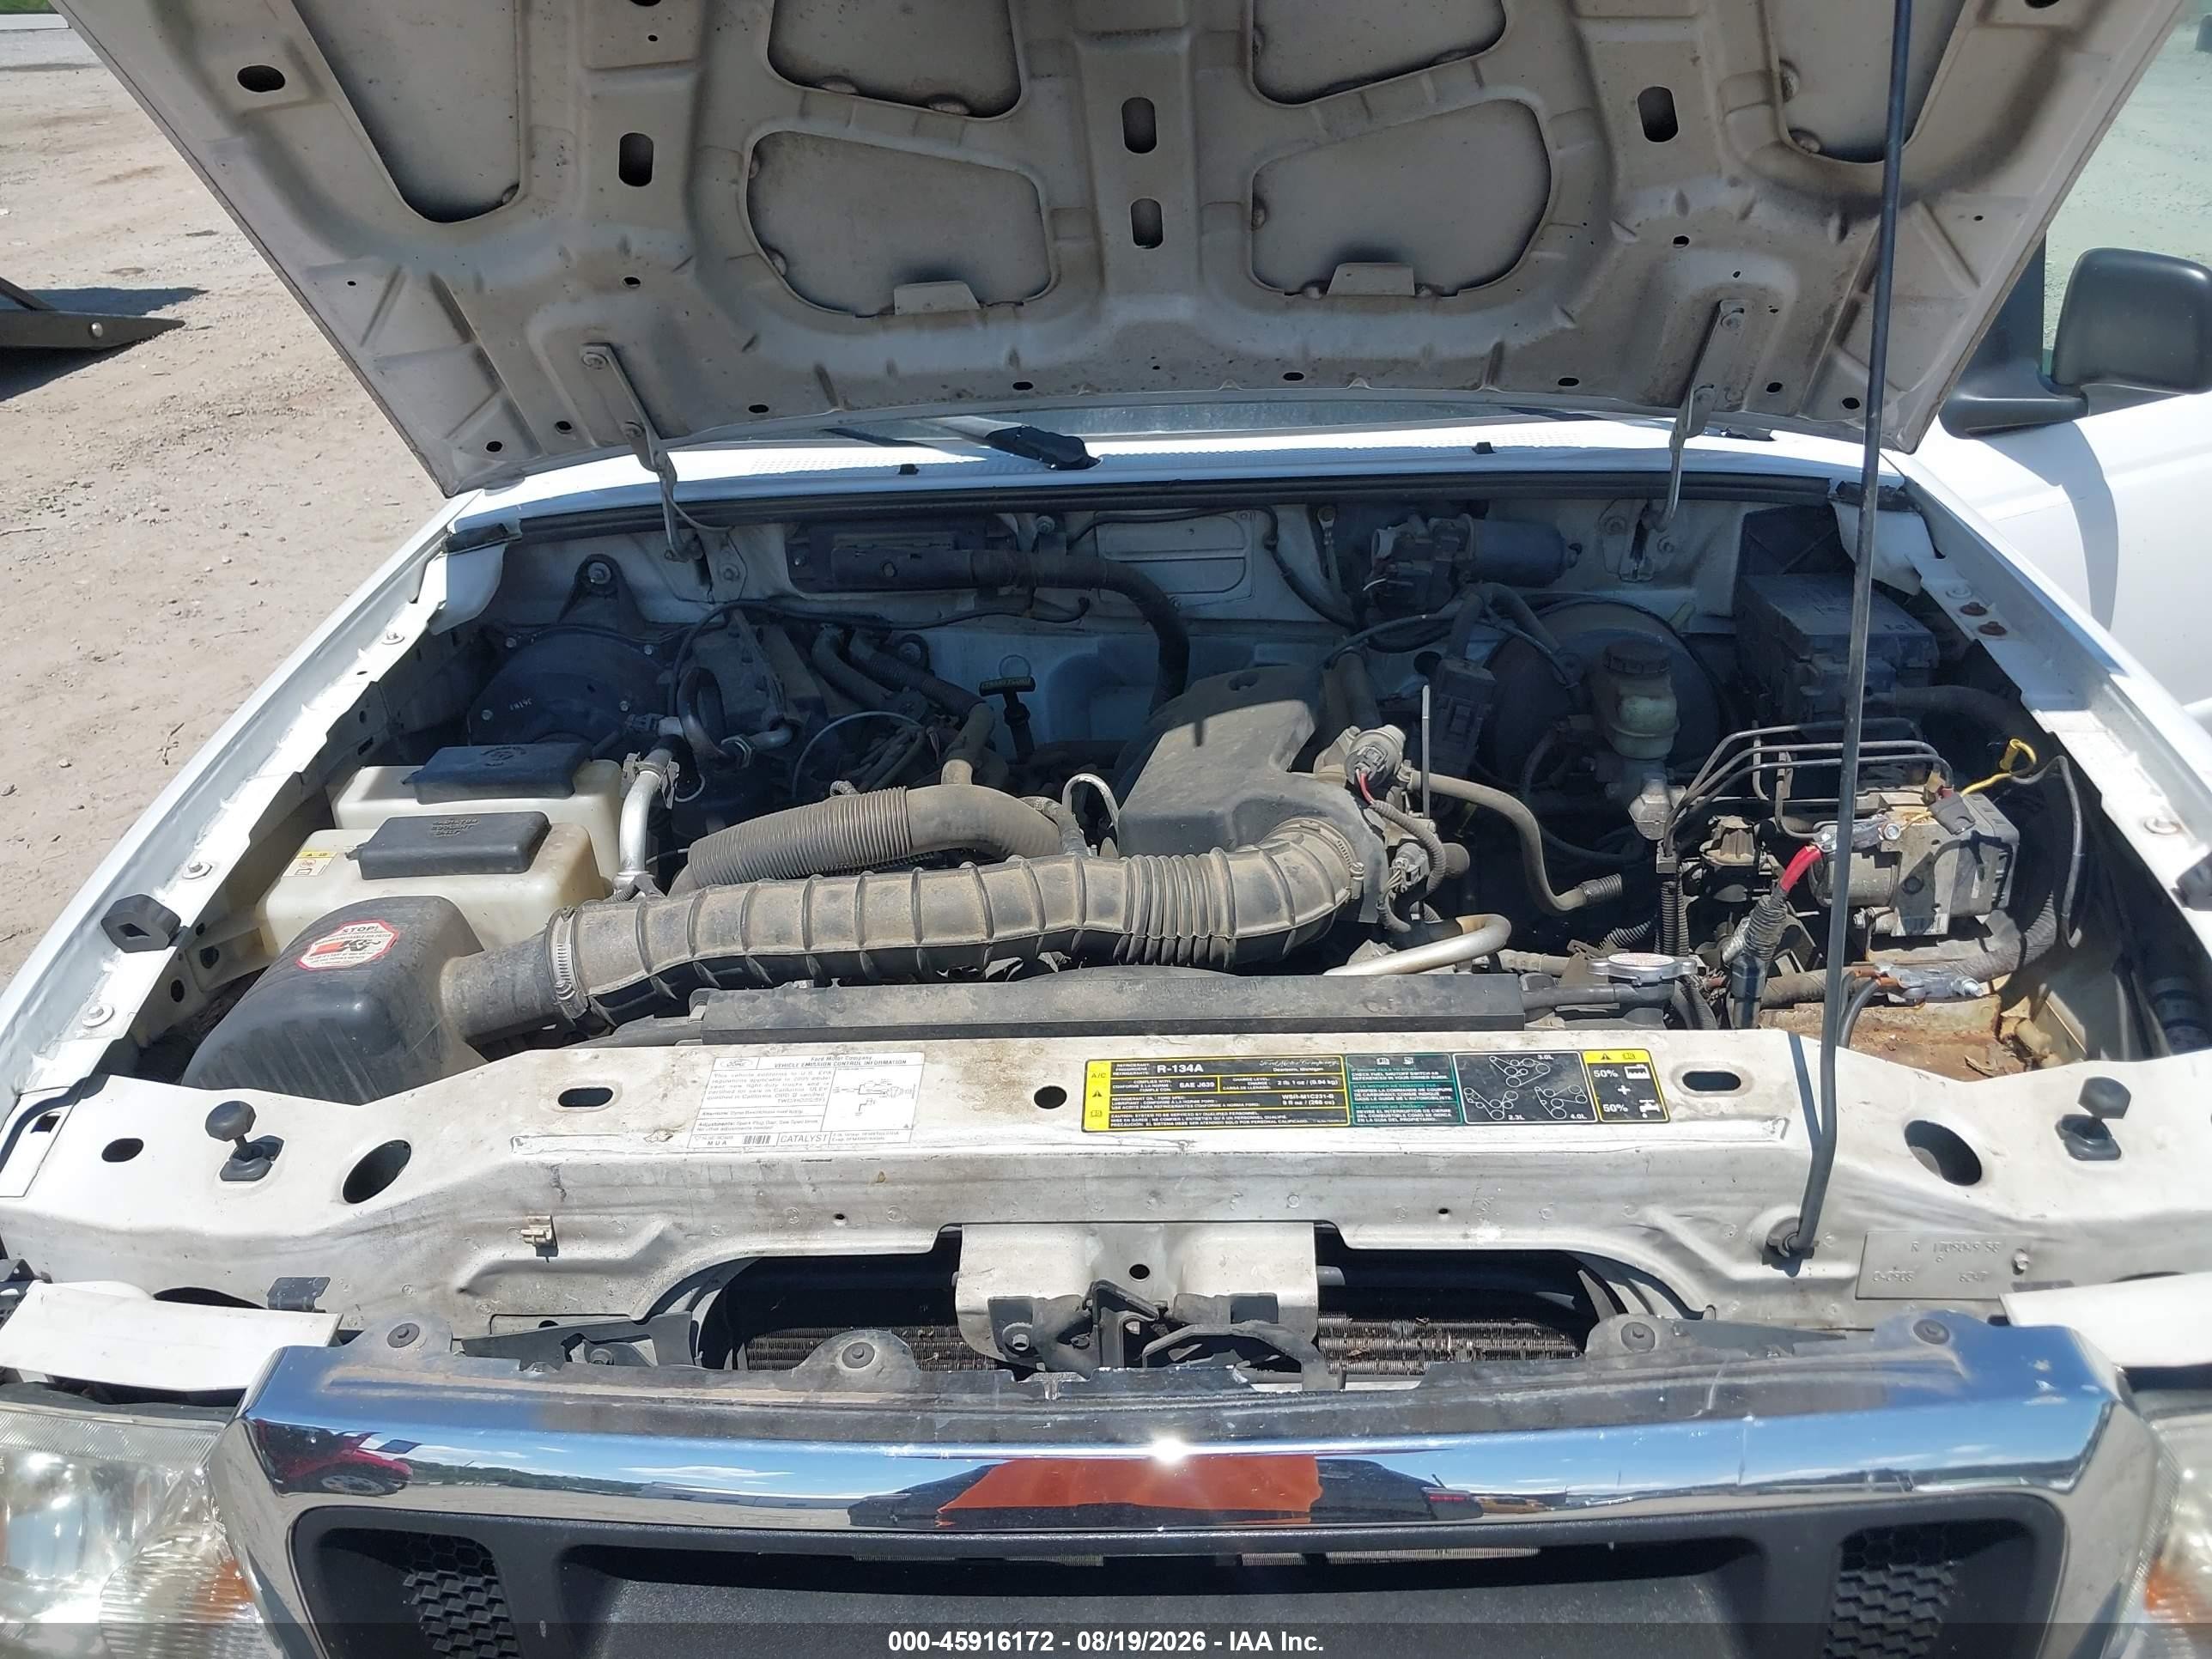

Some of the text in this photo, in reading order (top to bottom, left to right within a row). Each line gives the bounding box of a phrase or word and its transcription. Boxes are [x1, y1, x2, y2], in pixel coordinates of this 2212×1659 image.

[1157, 1064, 1204, 1073] R-134A
[1593, 1069, 1619, 1078] 50%
[1602, 1103, 1629, 1112] 50%
[781, 1133, 829, 1144] CATALYST
